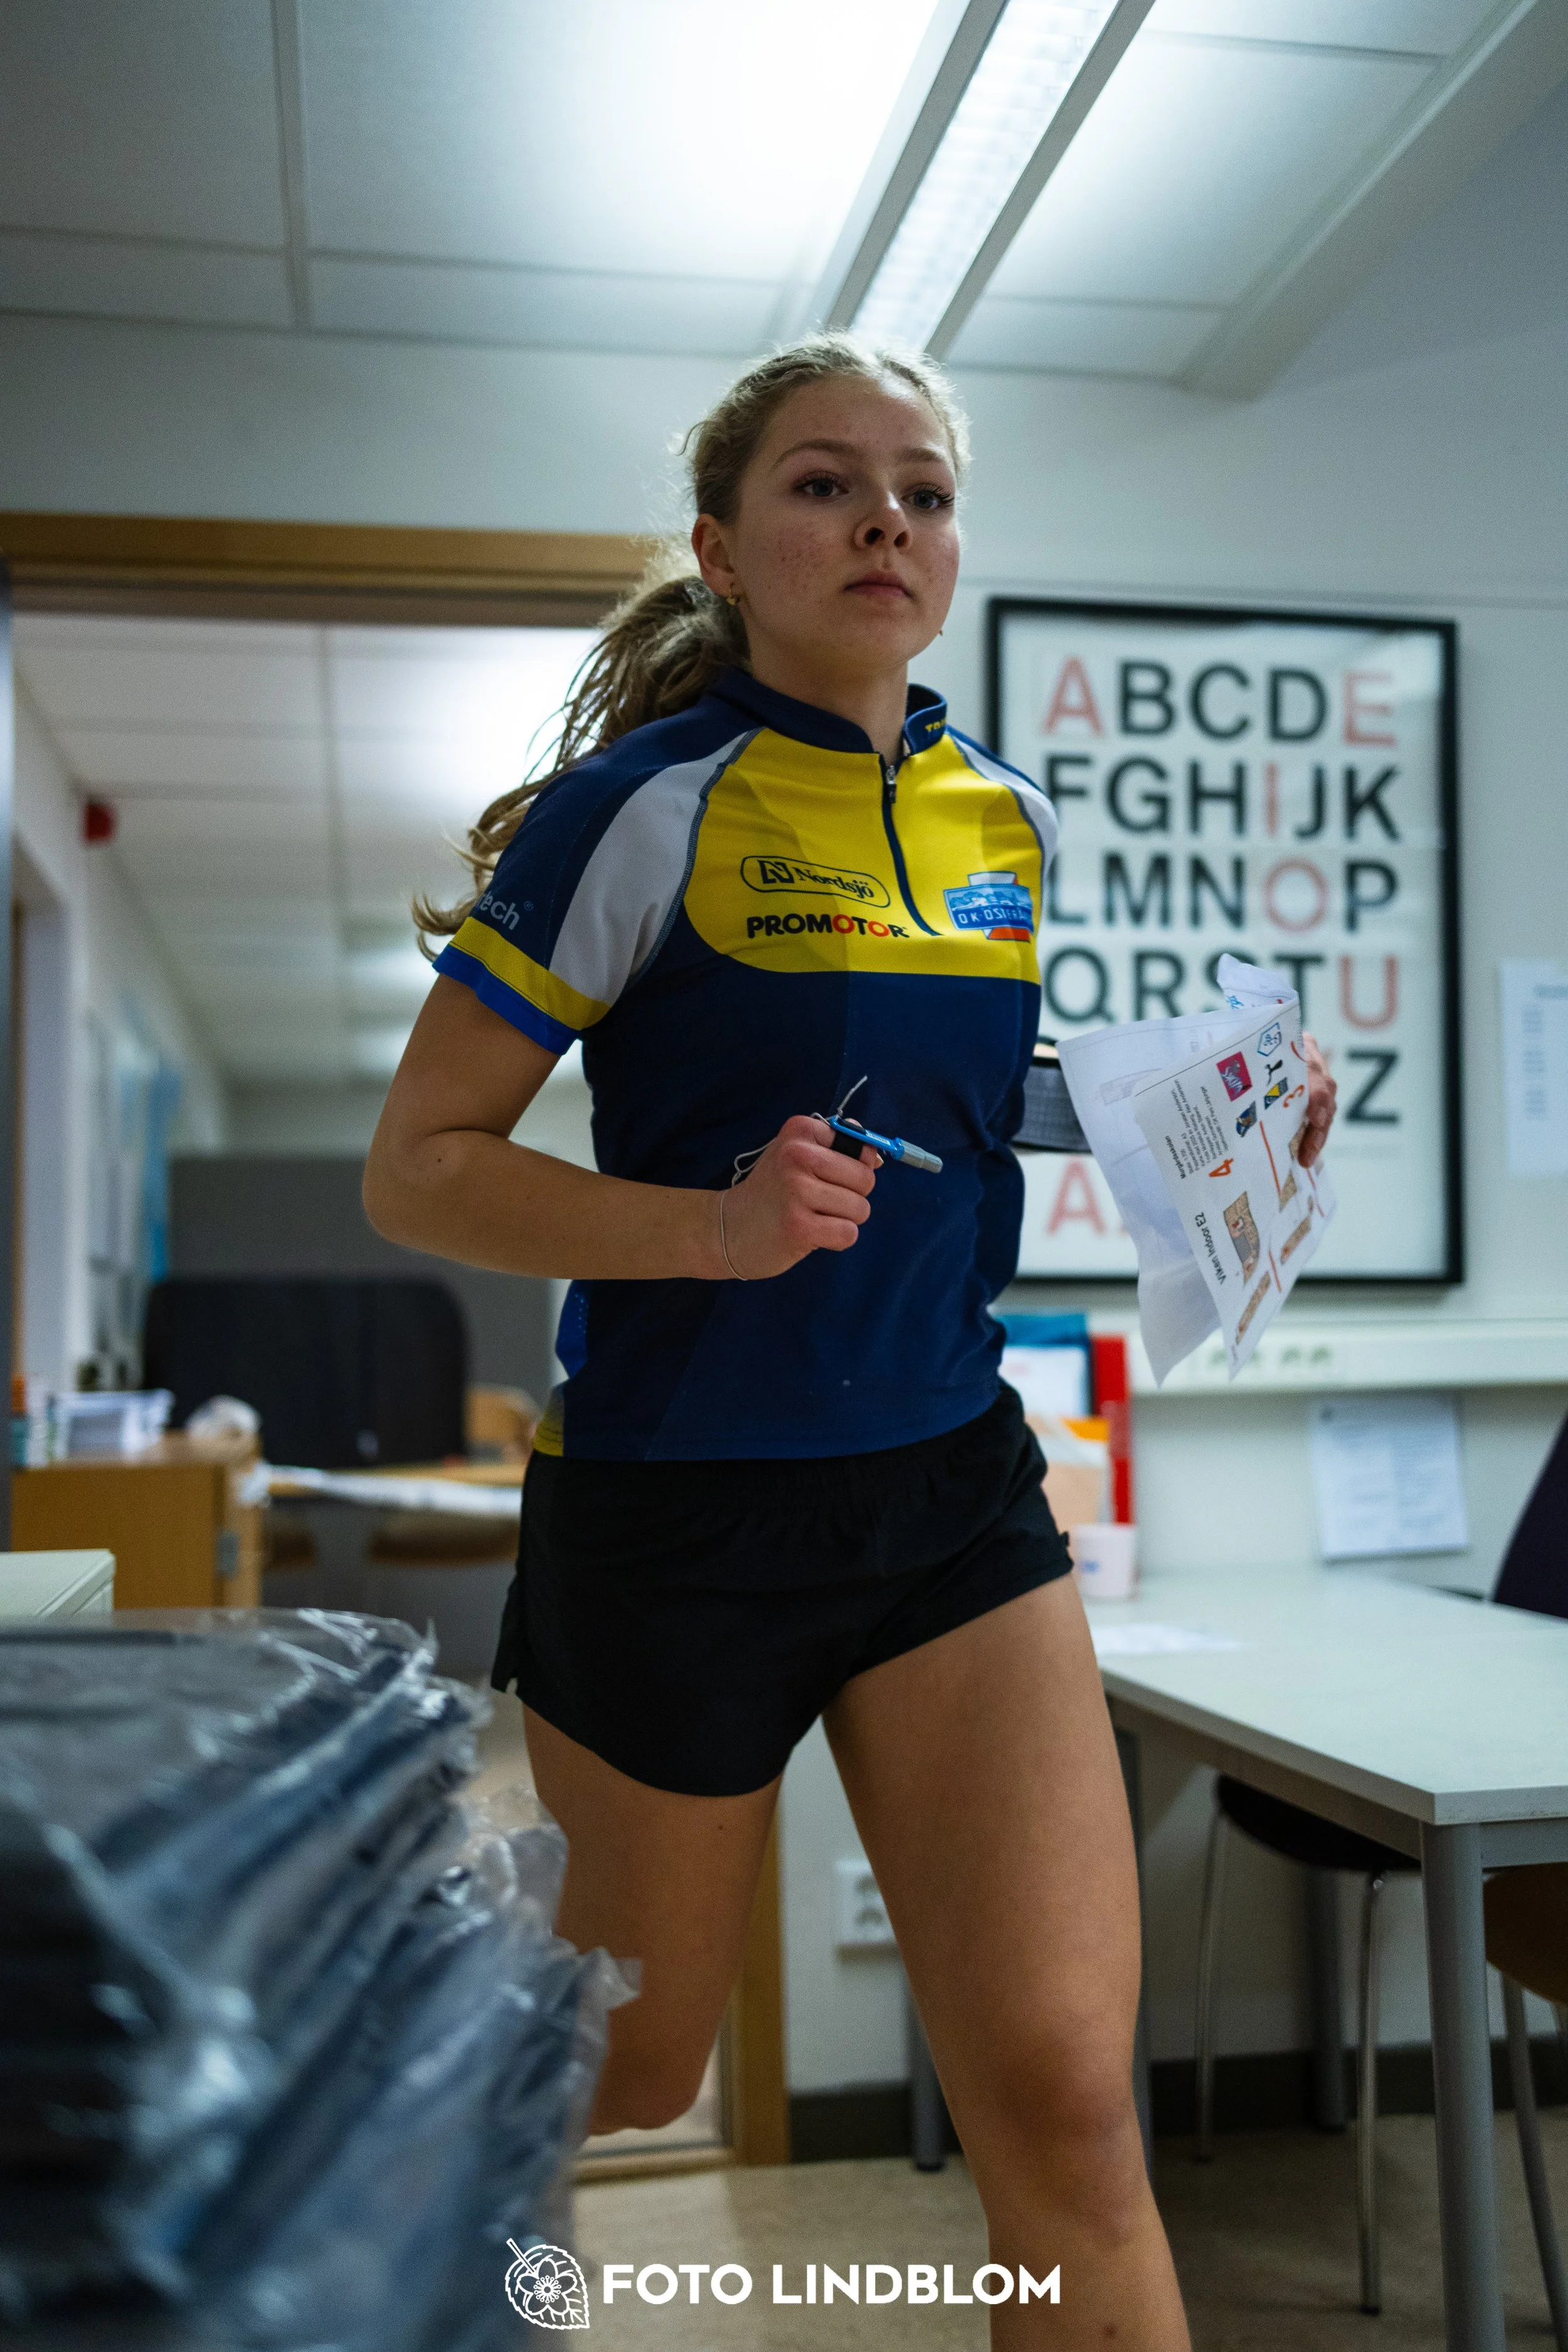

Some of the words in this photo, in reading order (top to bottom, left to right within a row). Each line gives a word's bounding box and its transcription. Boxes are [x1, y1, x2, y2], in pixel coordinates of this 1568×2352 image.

[1042, 656, 1397, 746] ABCDE
[1046, 755, 1401, 842] FGHIJK
[792, 867, 874, 899] Nordsjö
[1046, 853, 1398, 933] LMNOP
[478, 890, 520, 931] ech
[746, 913, 910, 939] PROMOTOR
[1194, 1212, 1206, 1227] E2
[1201, 1226, 1216, 1258] Indoor
